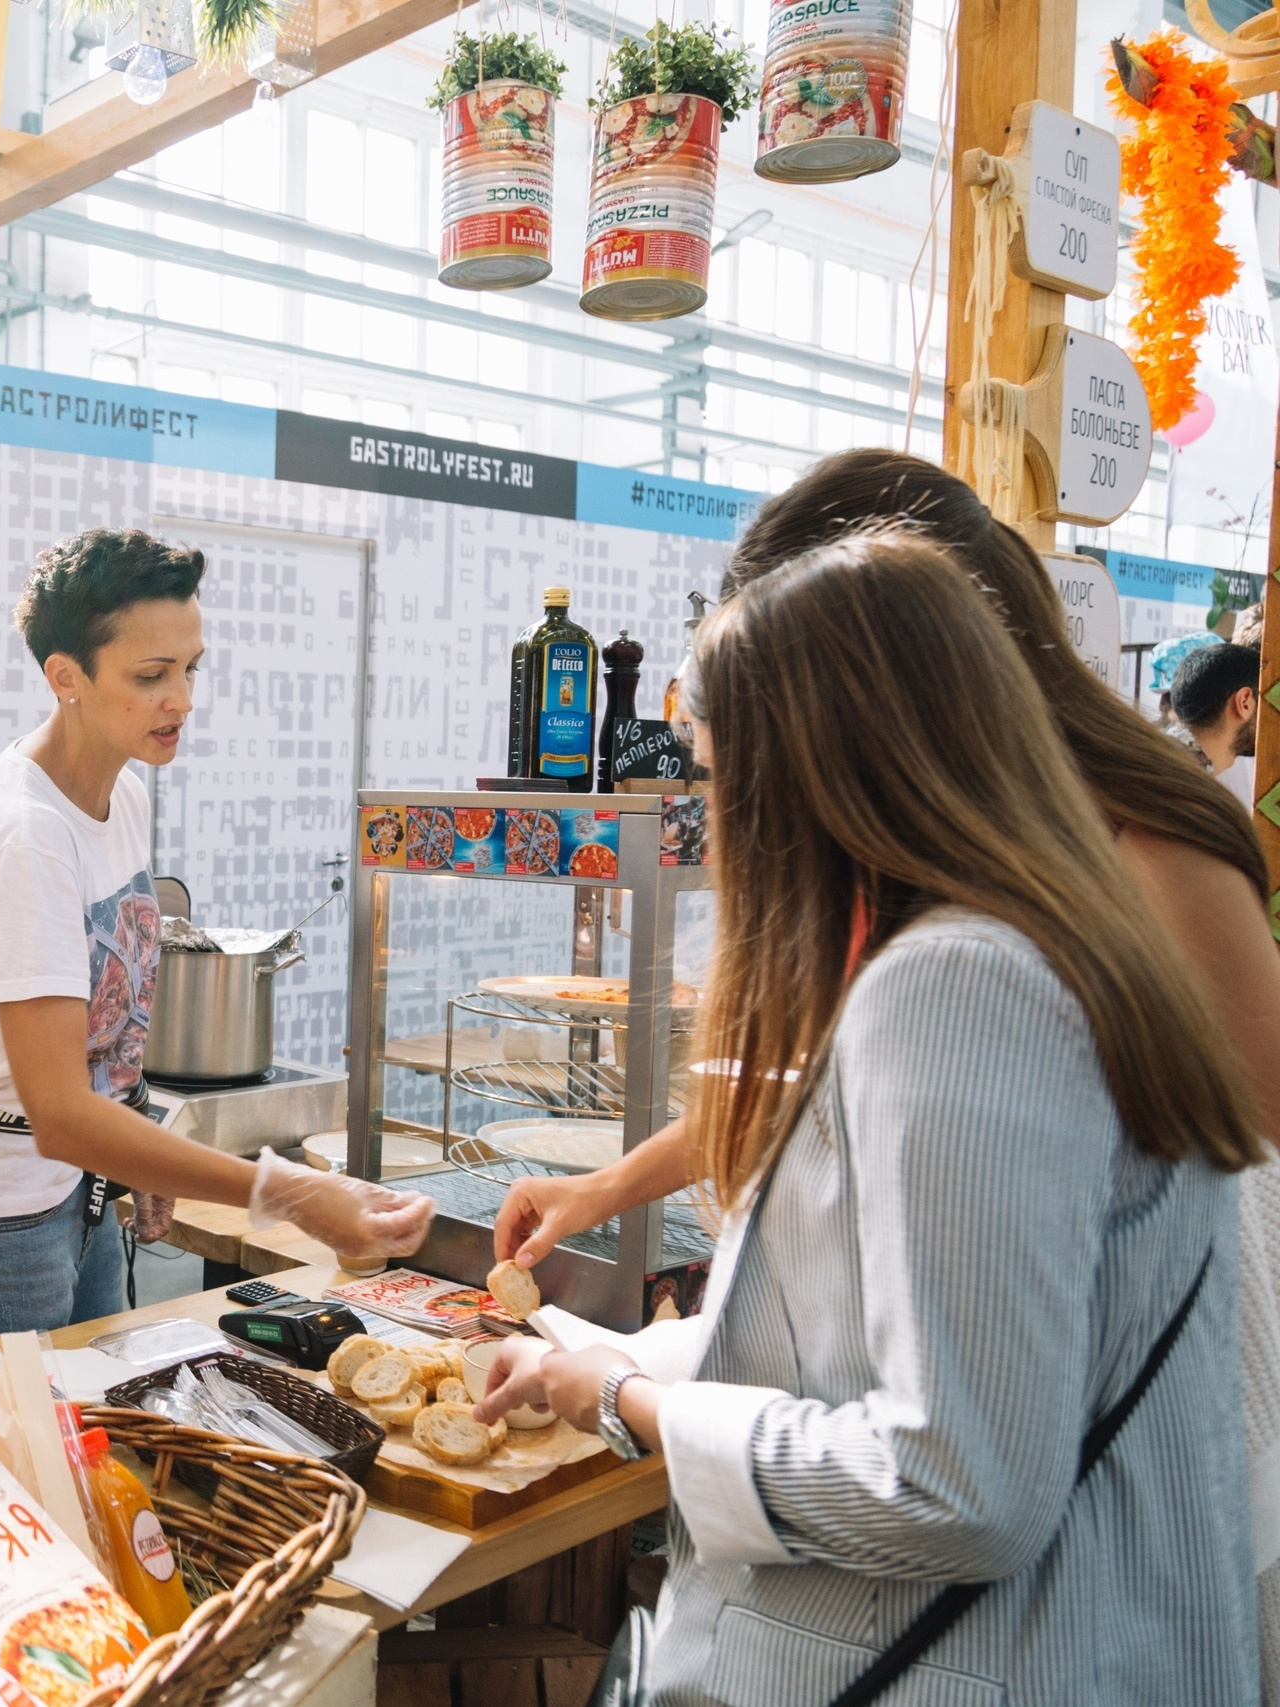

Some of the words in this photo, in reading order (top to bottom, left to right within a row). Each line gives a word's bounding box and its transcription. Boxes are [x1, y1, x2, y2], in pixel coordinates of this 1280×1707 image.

[1065, 149, 1088, 184] СУП
[1036, 176, 1041, 195] С
[1043, 179, 1077, 210] ПАСТОЙ
[1079, 196, 1112, 226] ФРЕСКА
[589, 248, 637, 272] MUTTI
[1059, 223, 1087, 264] 200
[1089, 376, 1125, 411] ПАСТА
[1070, 407, 1141, 450] БОЛОНЬЕЗЕ
[349, 436, 535, 490] GASTROLYFEST.RU
[1090, 453, 1117, 489] 200
[1119, 556, 1204, 590] #ГАСТРОЛИФЕСТ
[1059, 579, 1094, 608] МОРС
[554, 648, 582, 656] L'OLIO
[547, 717, 585, 727] Classico
[617, 720, 642, 747] 1/6
[656, 754, 682, 779] 90
